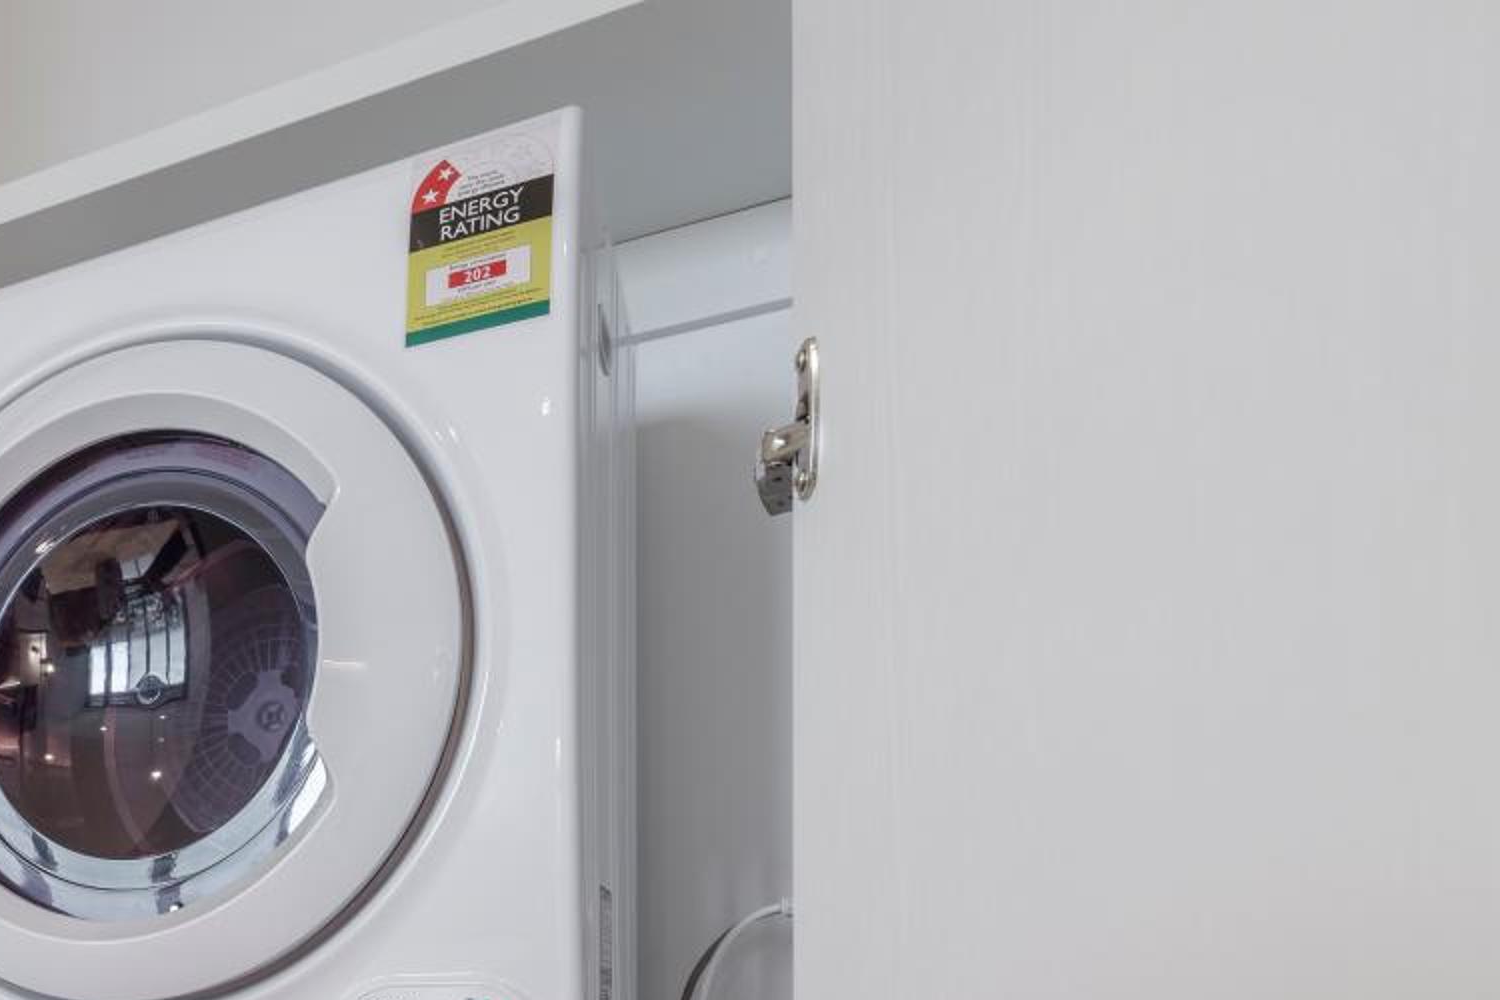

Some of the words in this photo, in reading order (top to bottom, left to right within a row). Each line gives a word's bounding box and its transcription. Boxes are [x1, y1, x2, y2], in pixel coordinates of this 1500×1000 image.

[438, 186, 525, 225] ENERGY
[440, 206, 520, 242] RATING
[464, 263, 492, 284] 202
